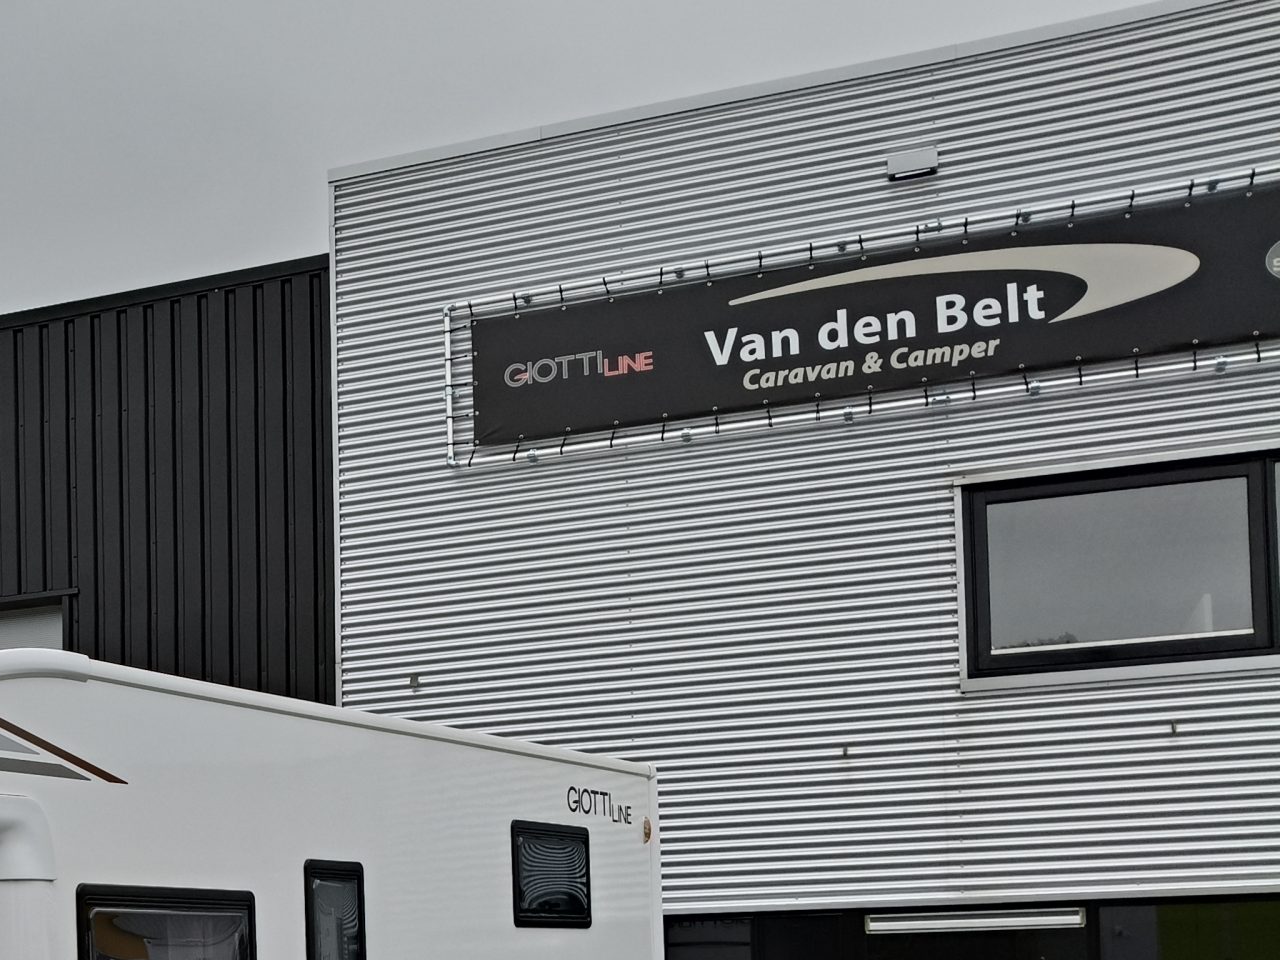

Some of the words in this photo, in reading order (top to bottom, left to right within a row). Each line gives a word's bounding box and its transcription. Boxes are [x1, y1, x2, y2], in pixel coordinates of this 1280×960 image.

[704, 326, 800, 366] Van
[817, 308, 917, 350] den
[935, 282, 1046, 334] Belt
[504, 350, 653, 387] GIOTTILINE
[742, 358, 855, 390] Caravan
[862, 352, 884, 374] &
[889, 337, 1001, 367] Camper
[566, 785, 632, 825] GIOTTILINE
